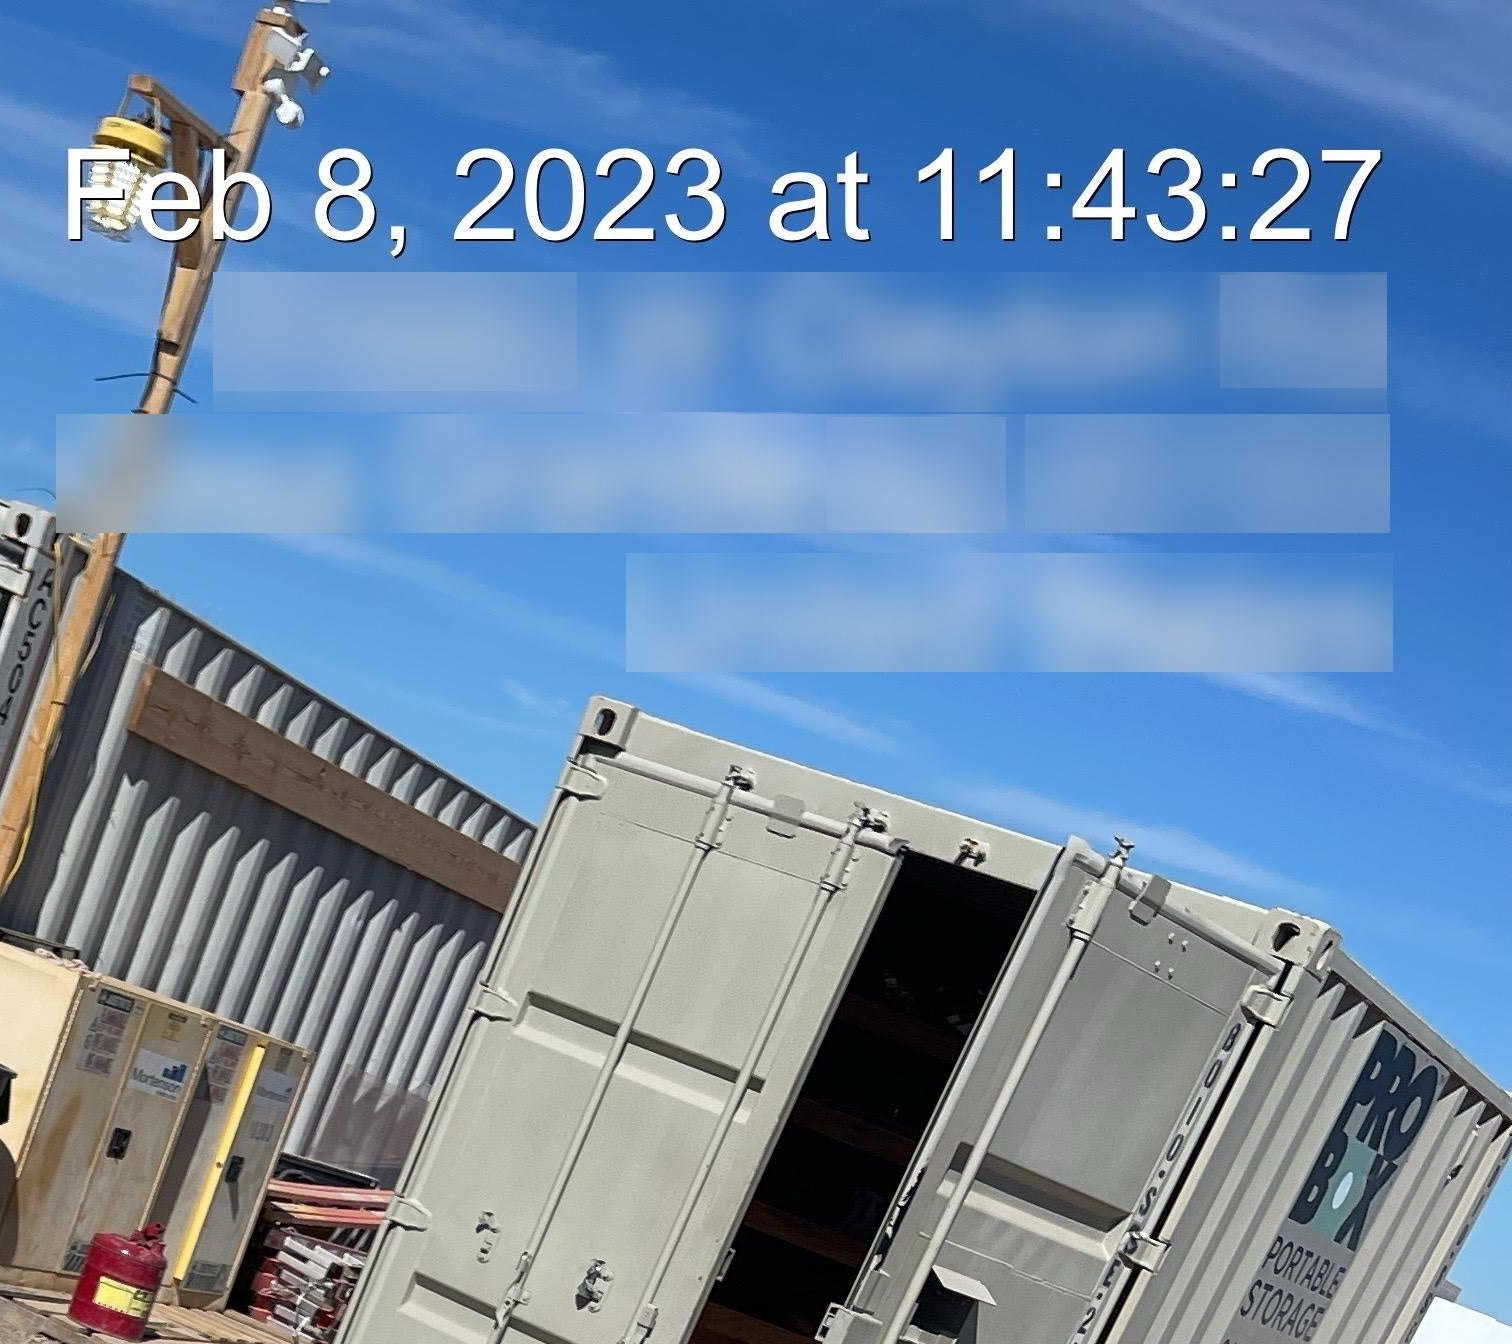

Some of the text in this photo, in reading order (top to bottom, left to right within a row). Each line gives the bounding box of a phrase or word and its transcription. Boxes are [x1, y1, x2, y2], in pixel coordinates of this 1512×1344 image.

[1335, 1027, 1440, 1164] PRO
[1287, 1127, 1399, 1253] BOX
[1239, 1278, 1326, 1343] STORAGE
[1260, 1235, 1348, 1299] PORTABLE
